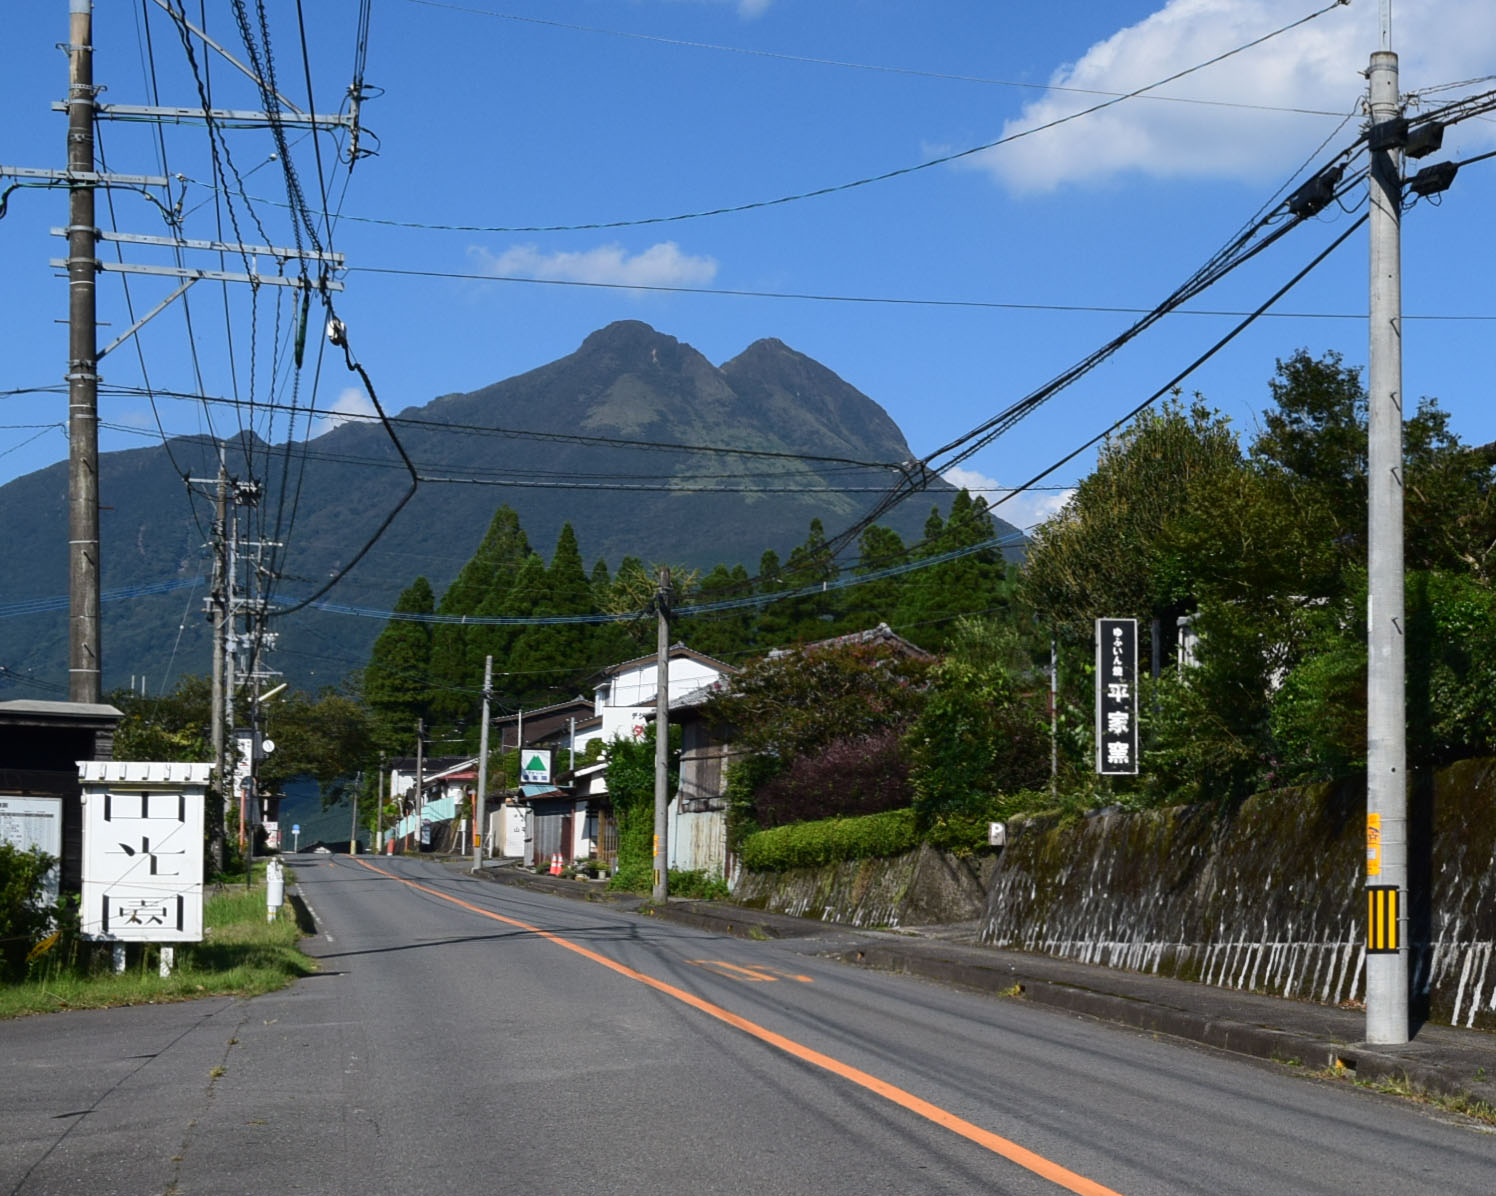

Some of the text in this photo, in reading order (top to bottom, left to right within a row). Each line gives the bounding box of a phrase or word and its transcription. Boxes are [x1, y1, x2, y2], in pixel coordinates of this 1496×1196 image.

[1107, 683, 1130, 764] 平家窯
[991, 822, 1004, 836] P
